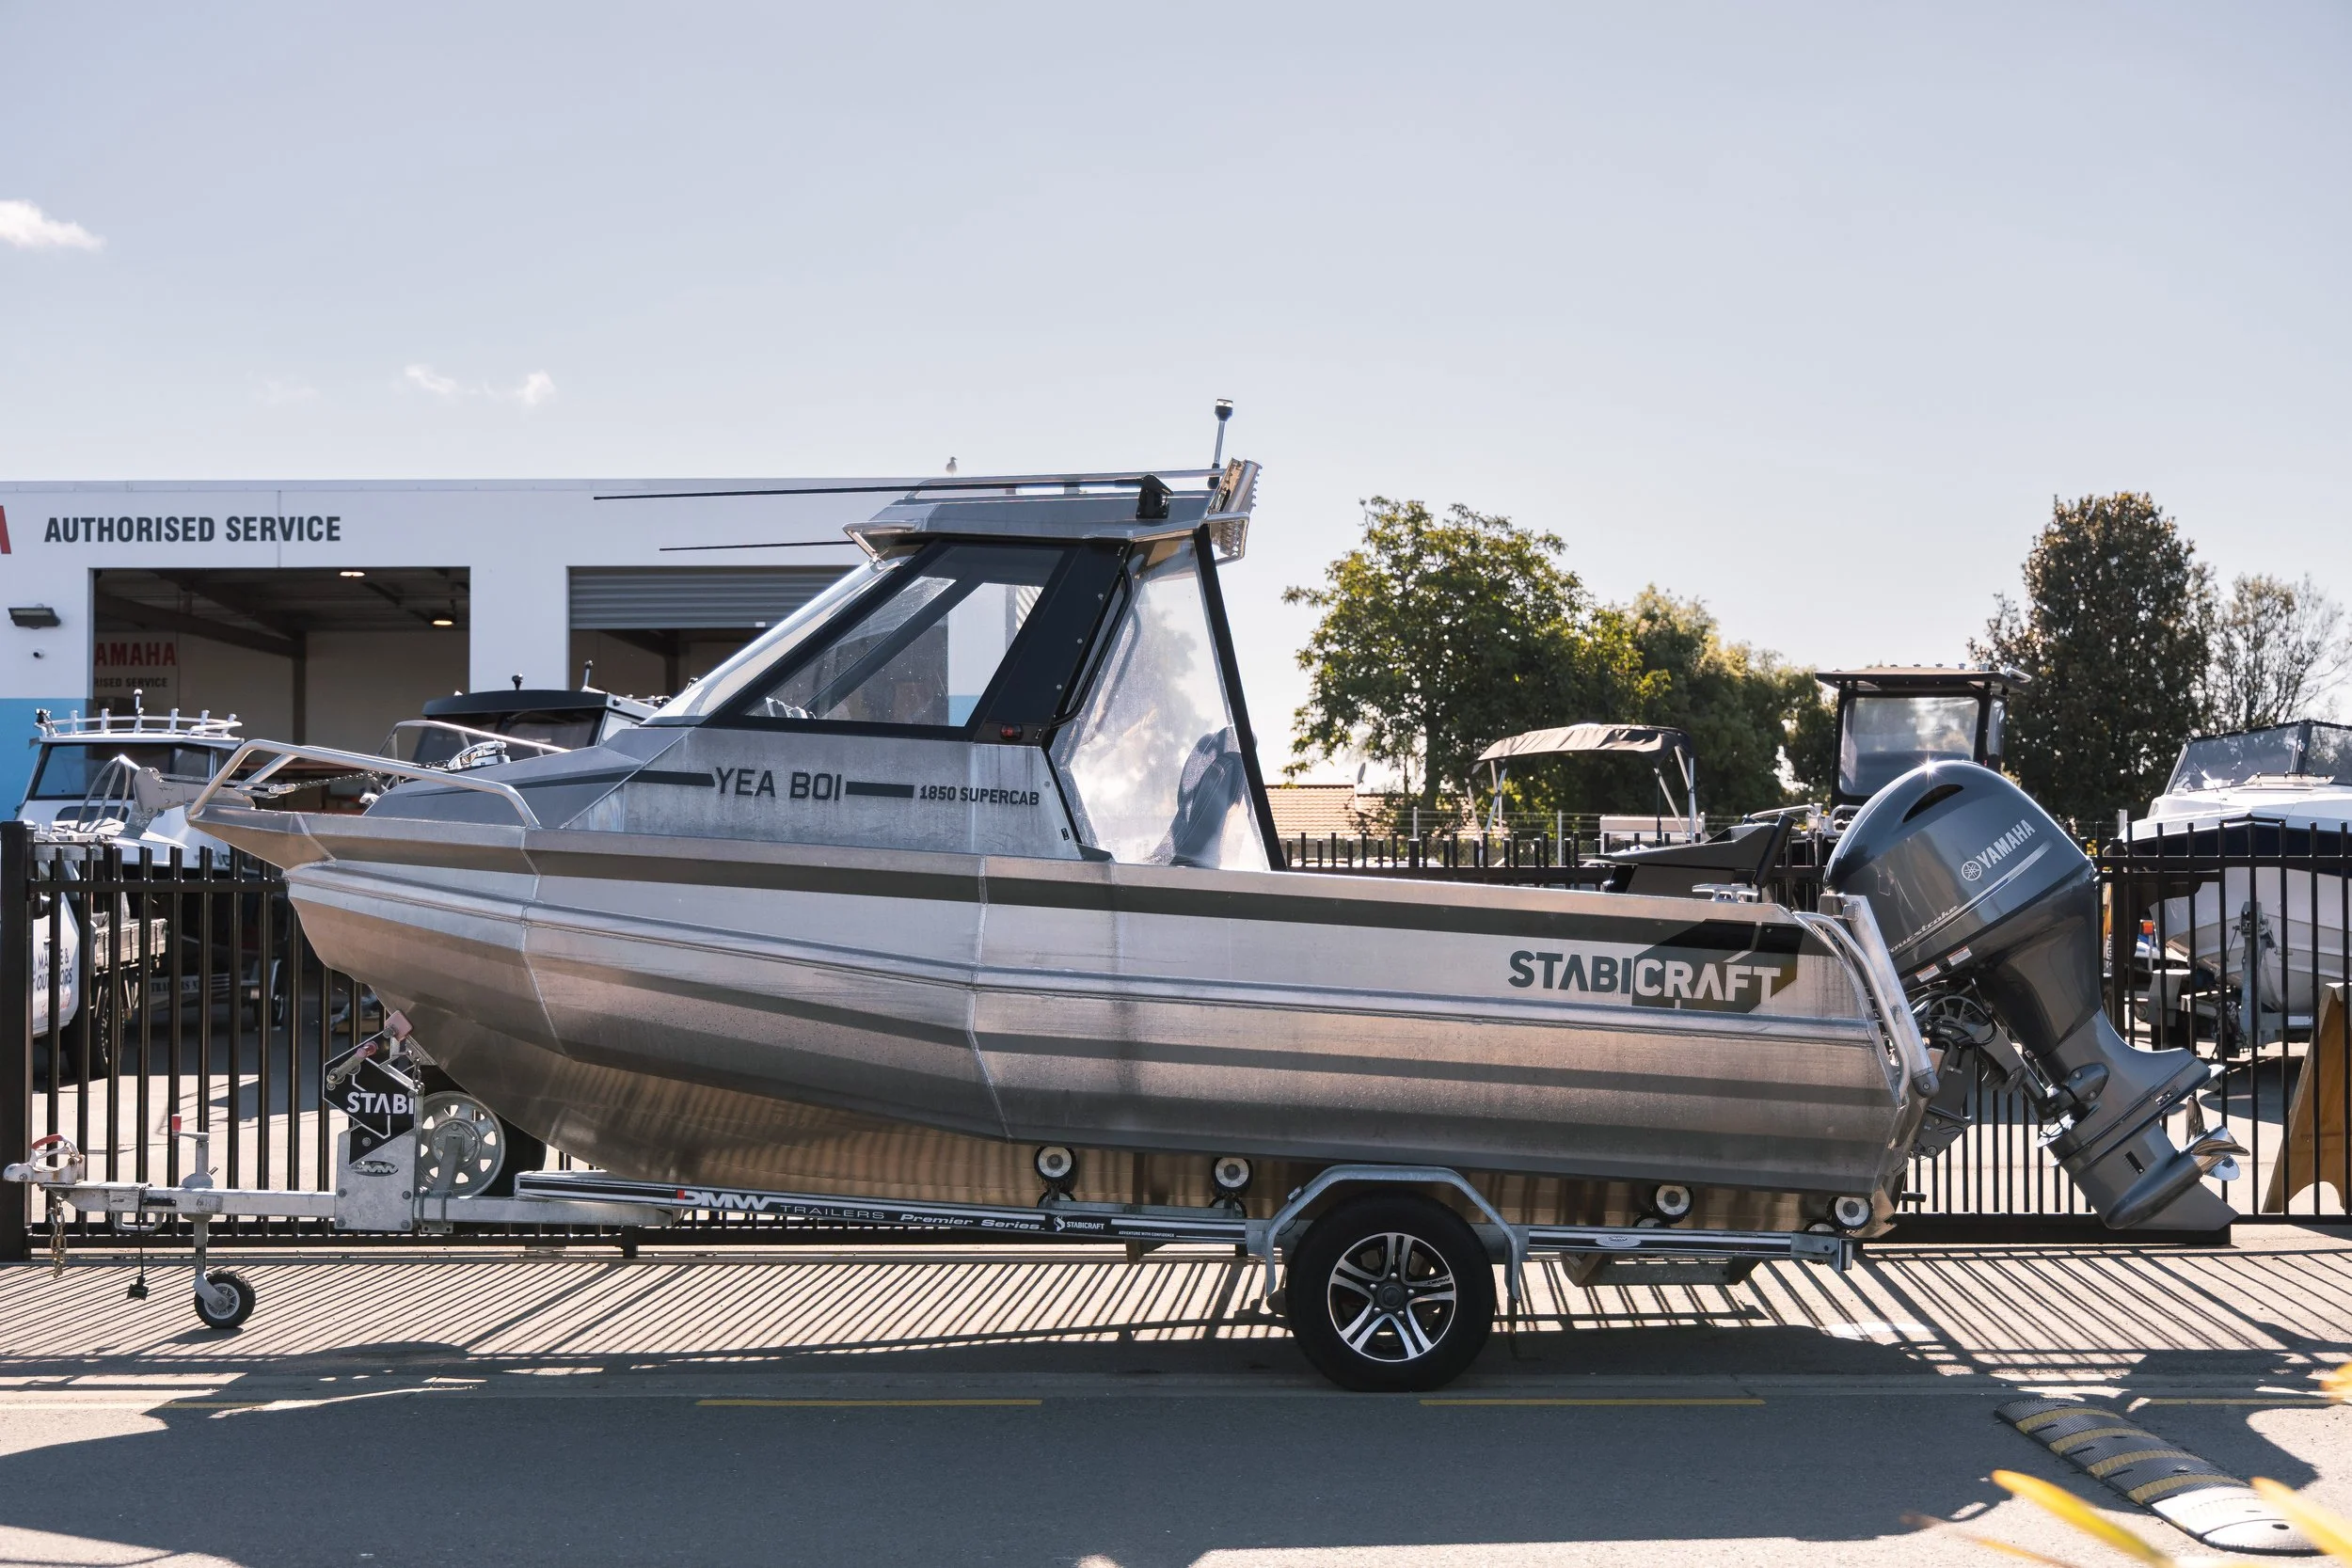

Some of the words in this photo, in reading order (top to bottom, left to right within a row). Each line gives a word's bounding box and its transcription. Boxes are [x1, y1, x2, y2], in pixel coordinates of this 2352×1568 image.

[44, 516, 215, 543] AUTHORISED
[225, 515, 341, 543] SERVICE
[125, 677, 167, 688] SERVICE
[715, 768, 776, 798] YEA
[790, 771, 842, 800] BOI
[919, 785, 957, 800] 1850
[960, 786, 1040, 806] SUPERCAB
[1976, 819, 2036, 869] YAMAHA
[1507, 950, 1781, 1004] STABICRAFT
[346, 1091, 414, 1115] STABI
[677, 1189, 771, 1211] DMW
[780, 1205, 884, 1219] TRAILERS
[899, 1213, 973, 1226] Premier
[1066, 1221, 1104, 1229] STABICRAFT
